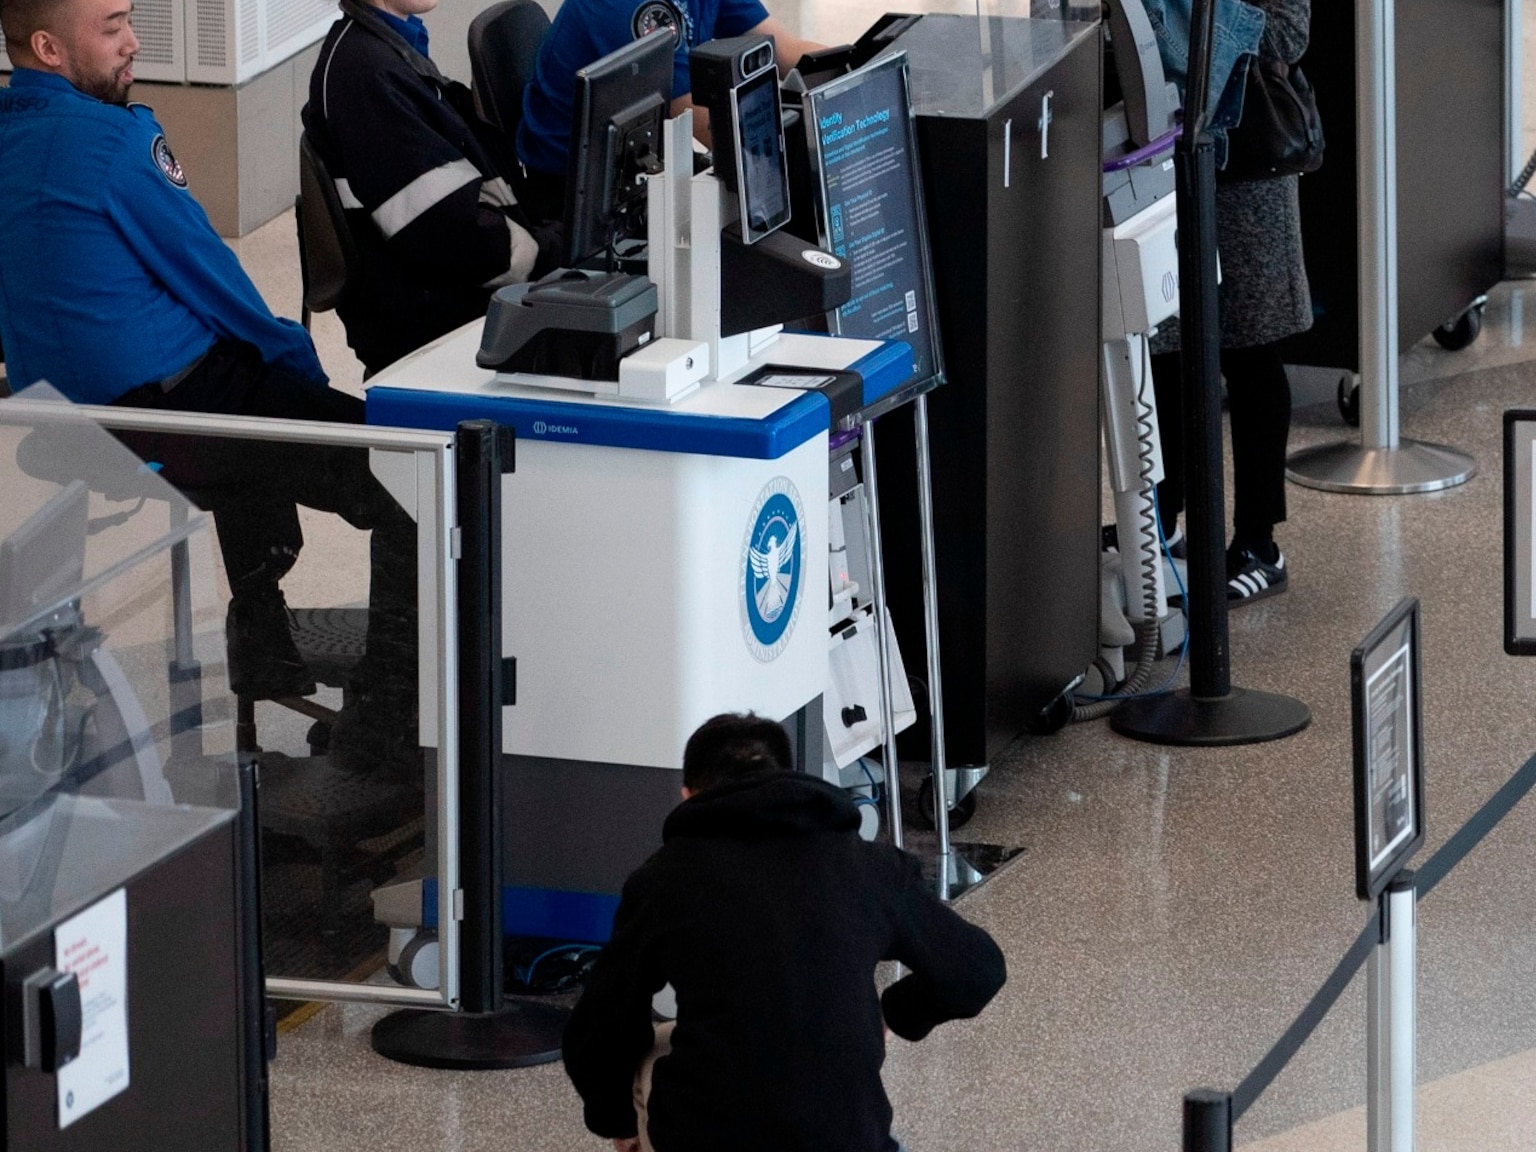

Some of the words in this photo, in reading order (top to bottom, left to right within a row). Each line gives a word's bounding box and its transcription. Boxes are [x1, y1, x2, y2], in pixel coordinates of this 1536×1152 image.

[820, 112, 842, 129] Identity
[822, 124, 856, 146] Verification
[855, 108, 890, 131] Technology
[548, 424, 579, 435] IDEMIA
